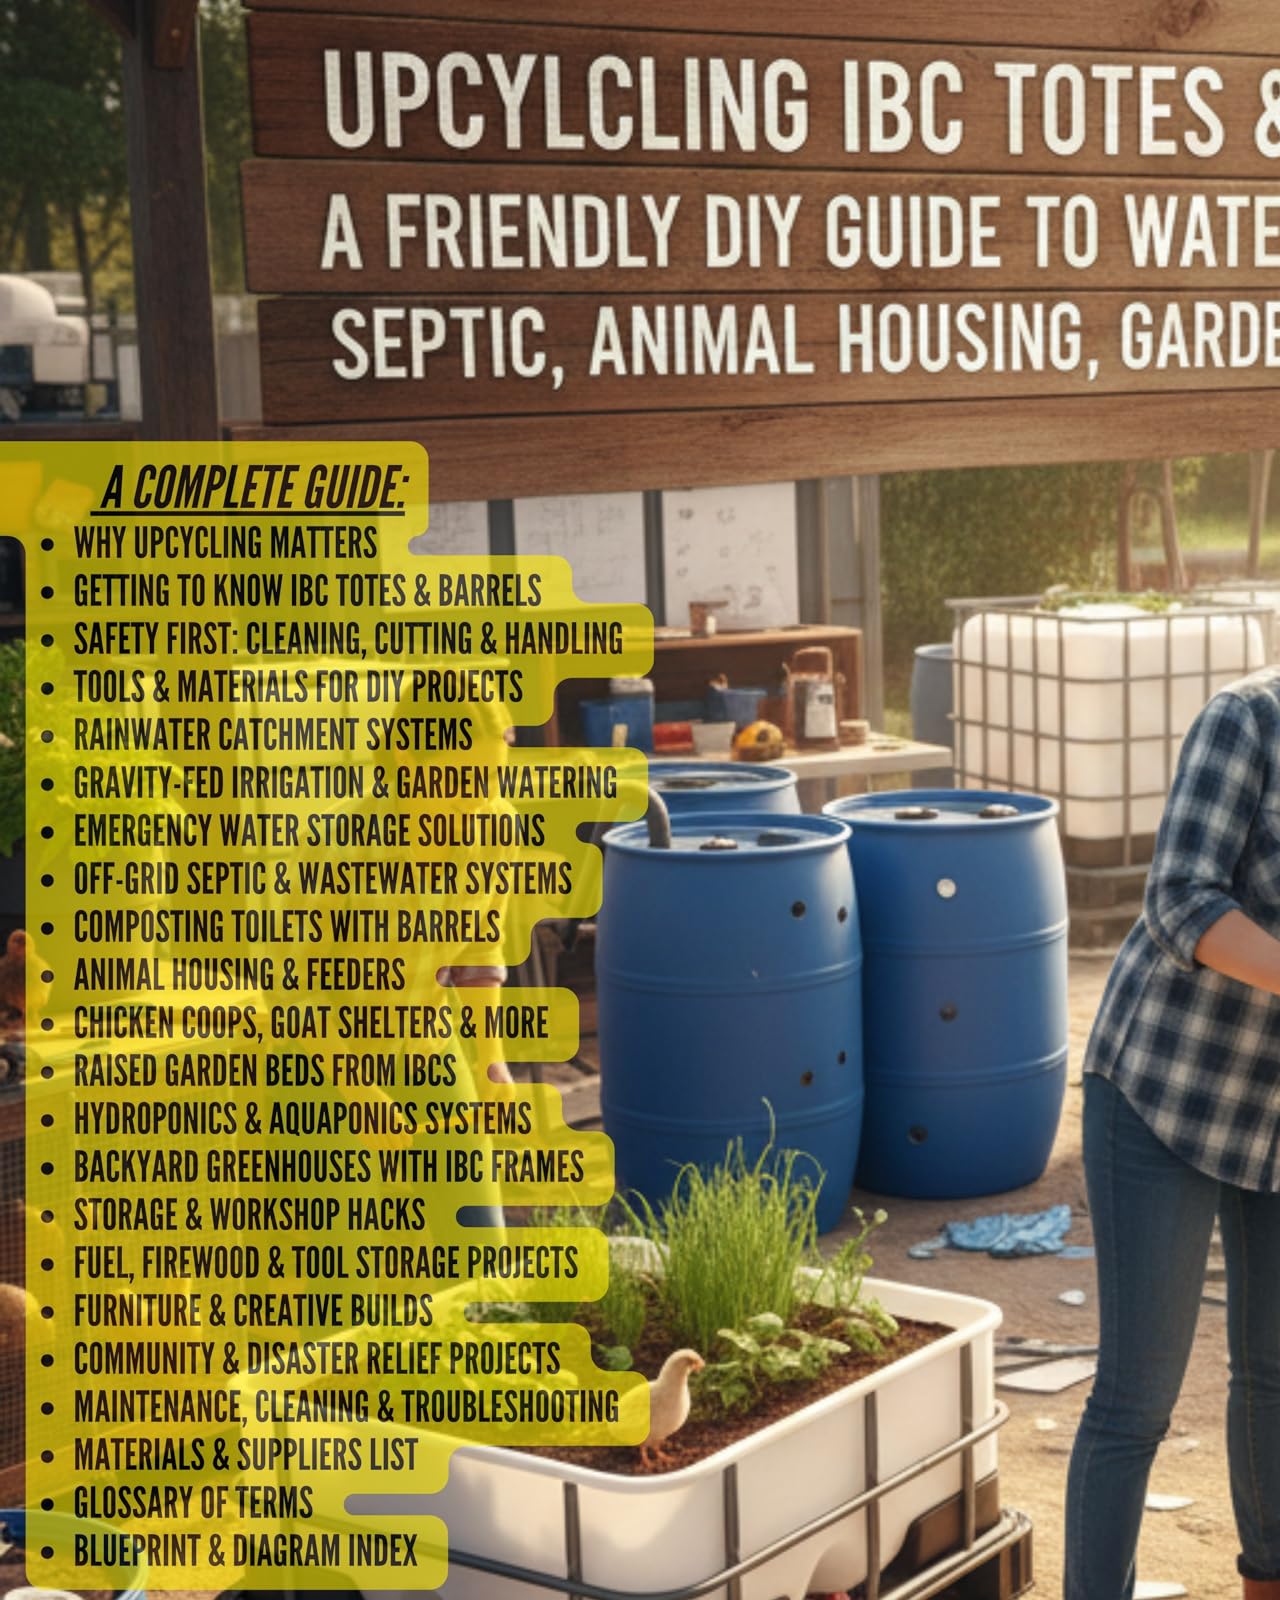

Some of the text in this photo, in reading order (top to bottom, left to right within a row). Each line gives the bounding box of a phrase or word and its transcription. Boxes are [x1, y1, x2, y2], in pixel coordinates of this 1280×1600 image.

[324, 49, 808, 153] UPCYLCLING
[844, 60, 963, 155] IBC
[995, 63, 1224, 157] TOTES
[320, 194, 363, 270] A
[387, 193, 680, 269] FRIENDLY
[705, 195, 802, 269] DIY
[826, 195, 1001, 269] GUIDE
[1027, 195, 1098, 269] TO
[331, 306, 564, 390] SEPTIC,
[589, 305, 814, 376] ANIMAL
[839, 302, 1099, 380] HOUSING,
